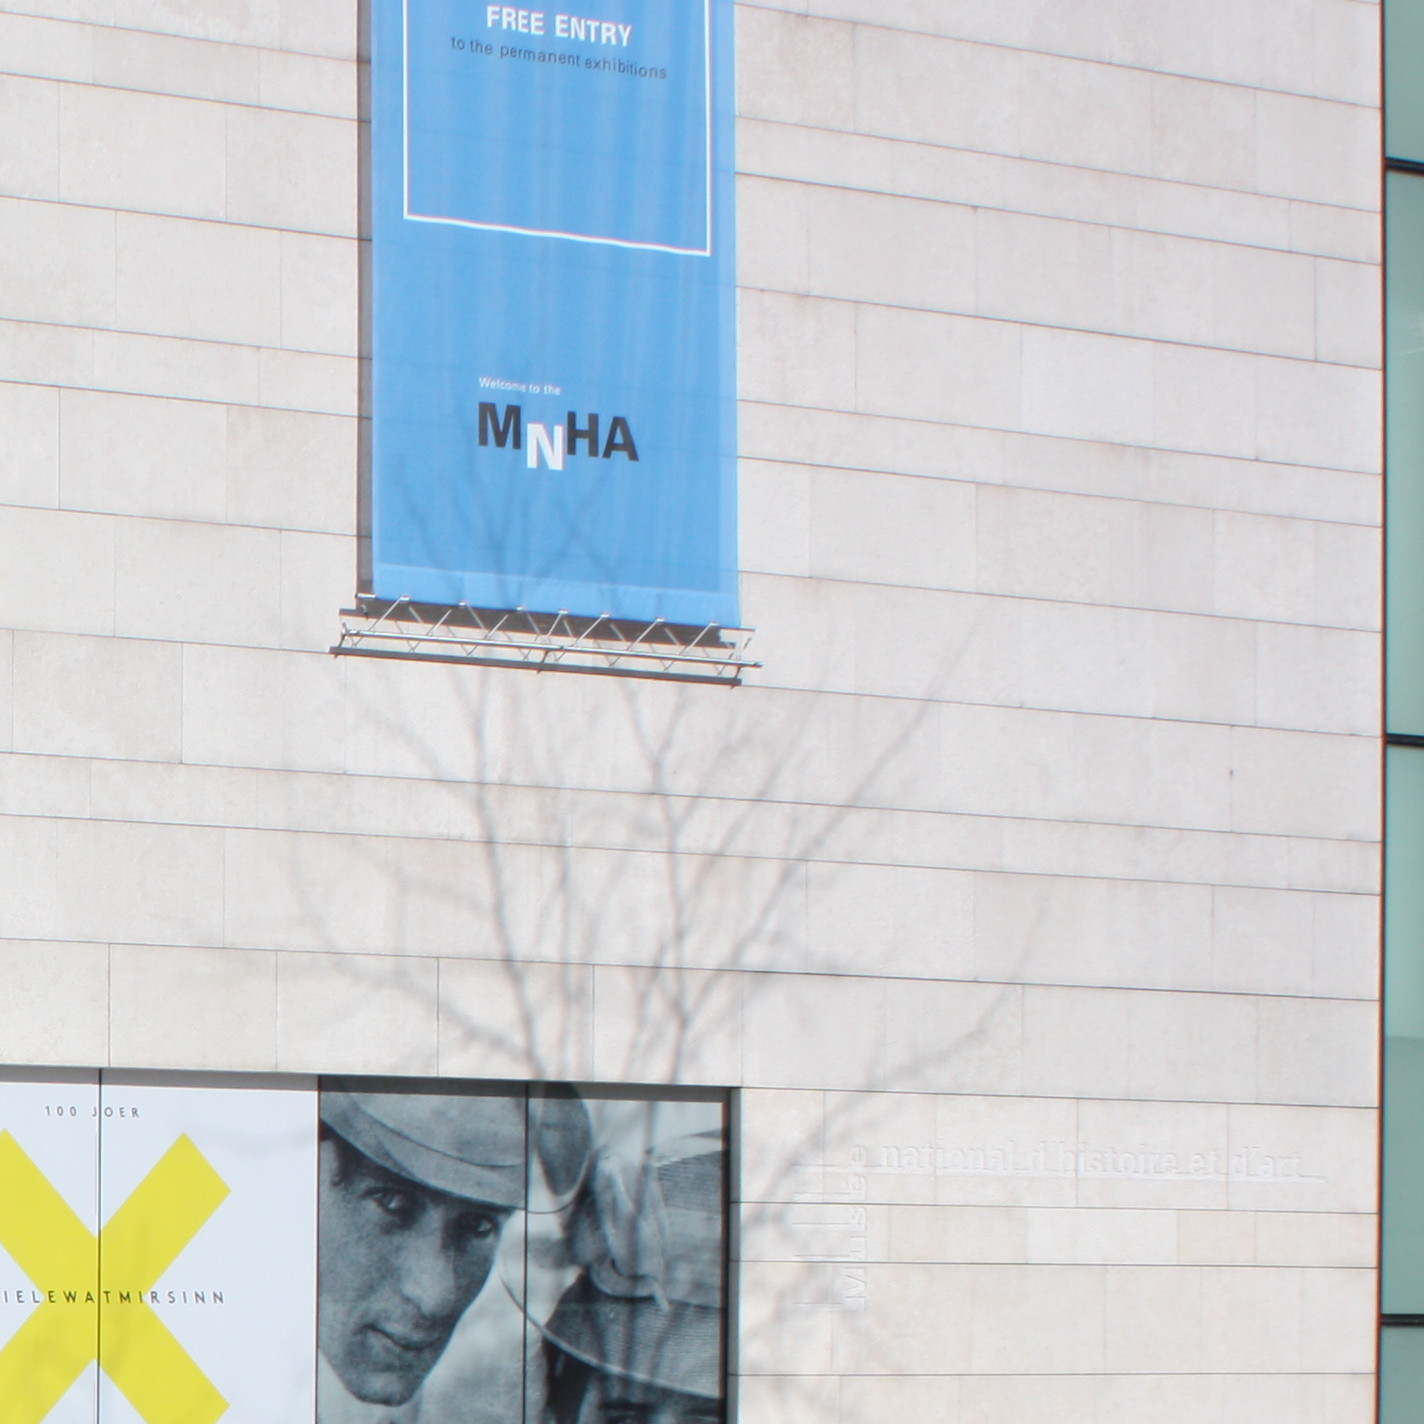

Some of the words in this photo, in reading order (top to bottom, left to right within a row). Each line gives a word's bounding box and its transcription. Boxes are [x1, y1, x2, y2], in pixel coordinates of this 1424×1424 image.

[486, 5, 544, 36] FREE
[555, 14, 633, 47] ENTRY
[451, 36, 465, 51] to
[469, 39, 493, 56] the
[499, 44, 580, 67] permanent
[584, 57, 668, 80] exhibitions
[479, 377, 527, 393] Welcome
[529, 382, 540, 395] to
[543, 384, 561, 396] the
[477, 401, 639, 471] MNHA
[44, 1105, 78, 1117] 100
[91, 1106, 141, 1118] JOER
[880, 1140, 1014, 1170] national
